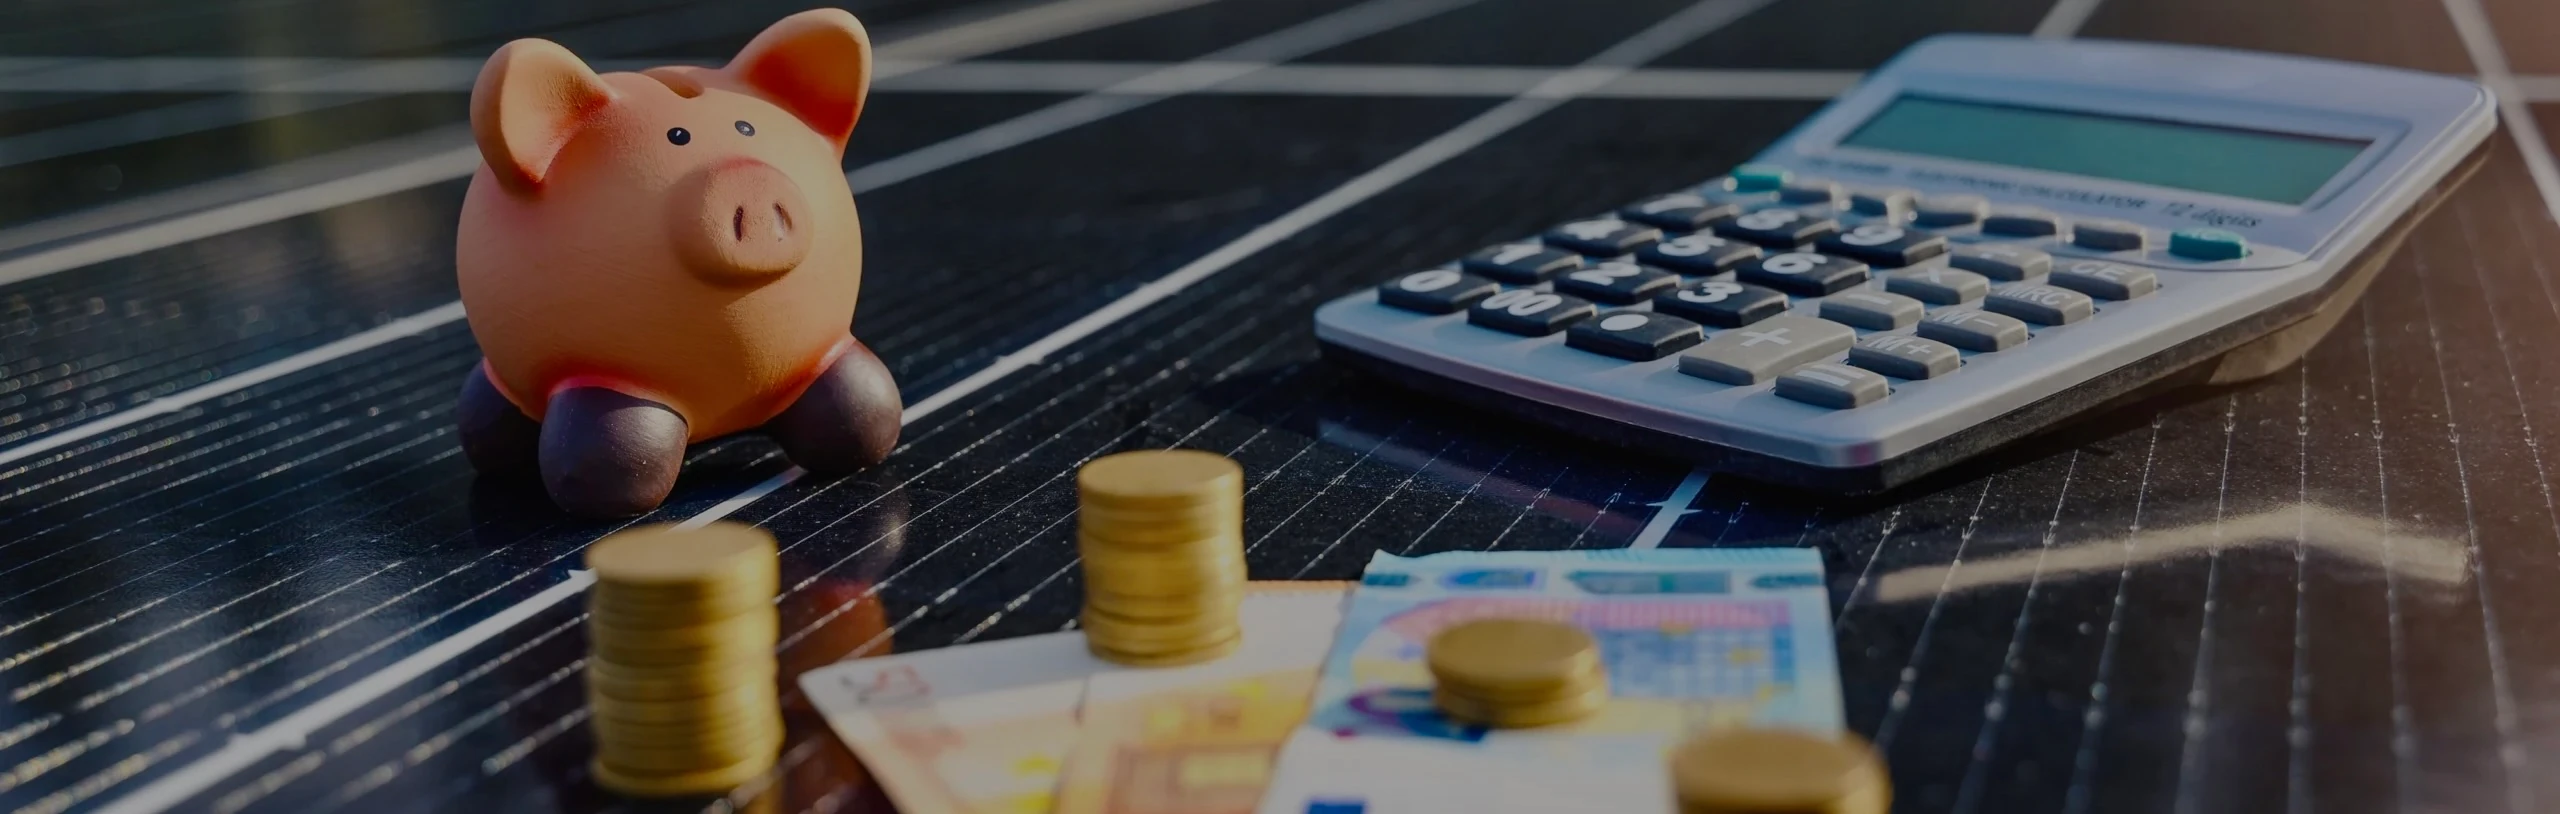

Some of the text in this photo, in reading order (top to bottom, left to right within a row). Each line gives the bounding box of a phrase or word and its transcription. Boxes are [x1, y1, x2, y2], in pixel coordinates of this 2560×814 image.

[1657, 234, 1727, 256] 5
[1840, 224, 1906, 246] 9
[1569, 261, 1642, 286] 2
[1761, 251, 1828, 276] 6
[2070, 261, 2128, 282] CE
[1399, 269, 1461, 293] 0
[1677, 281, 1743, 304] 3
[1480, 288, 1563, 317] 00
[1866, 334, 1934, 355] M+
